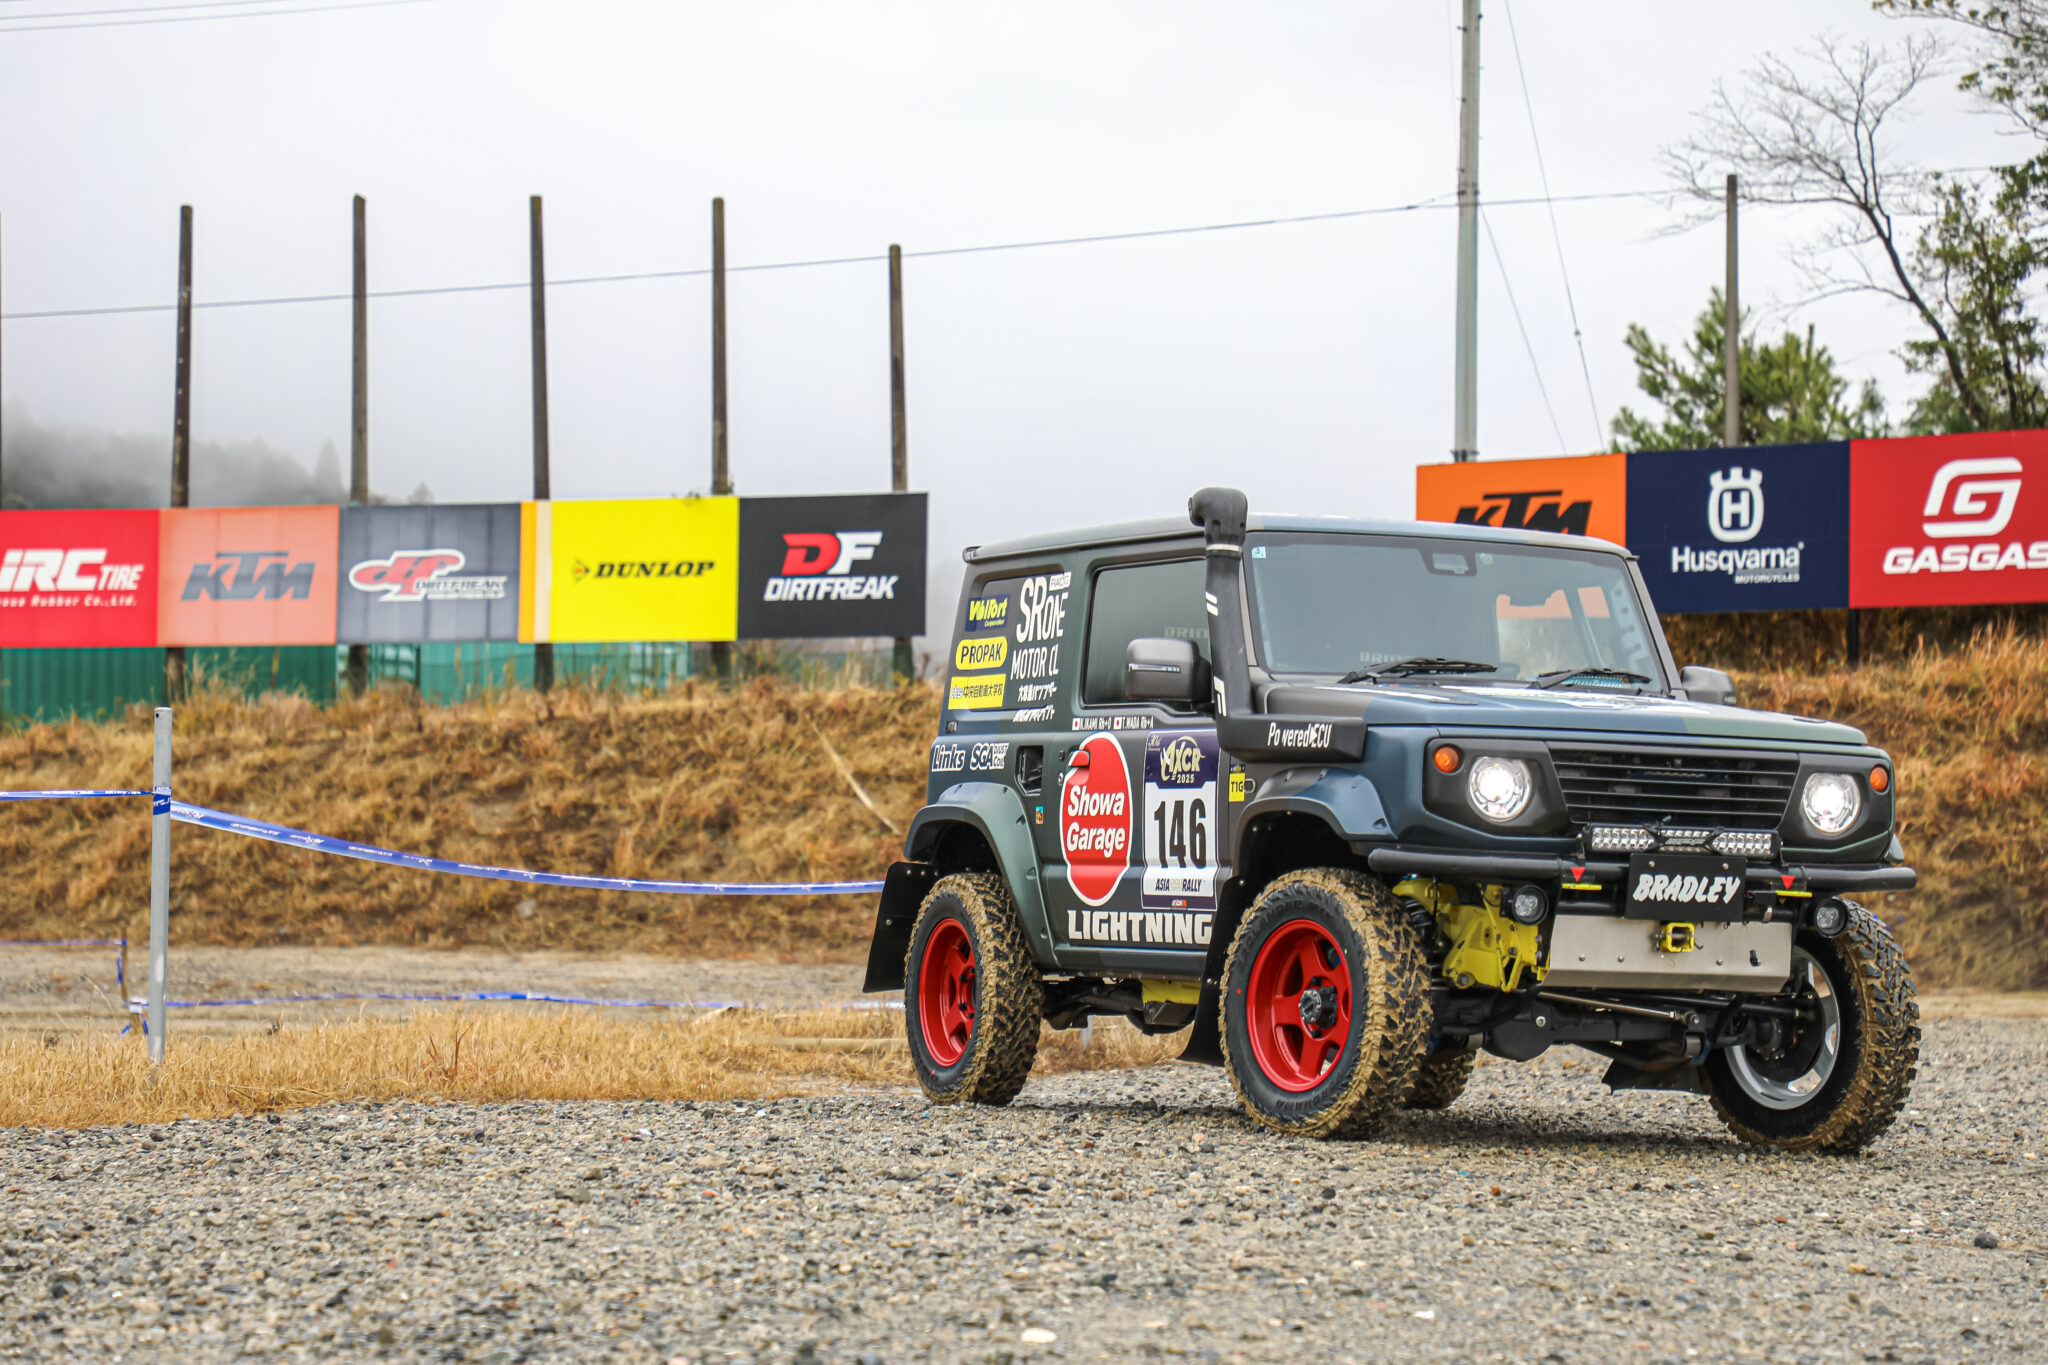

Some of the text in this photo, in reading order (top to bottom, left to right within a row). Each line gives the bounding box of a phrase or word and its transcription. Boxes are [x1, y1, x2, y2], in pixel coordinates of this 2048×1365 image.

[782, 530, 883, 576] DF
[1671, 545, 1801, 576] Husqvarna
[1882, 541, 2048, 575] GASGAS
[98, 563, 145, 591] TIRE
[180, 550, 315, 601] KTM
[593, 560, 715, 580] DUNLOP
[1733, 573, 1801, 585] MOTORCYCLES
[31, 595, 80, 608] Rubber
[763, 575, 899, 602] DIRTFREAK
[960, 642, 1003, 664] PROPAK
[1010, 646, 1048, 680] MOTOR
[932, 743, 994, 772] Links SGA
[1176, 773, 1195, 784] 2025
[1067, 785, 1124, 818] Showa
[1066, 822, 1126, 858] Garage
[1153, 798, 1207, 870] 146
[1155, 878, 1170, 892] ASIA
[1182, 878, 1202, 892] RALLY
[1631, 872, 1741, 904] BRADLEY
[1067, 909, 1213, 945] LIGHTNING
